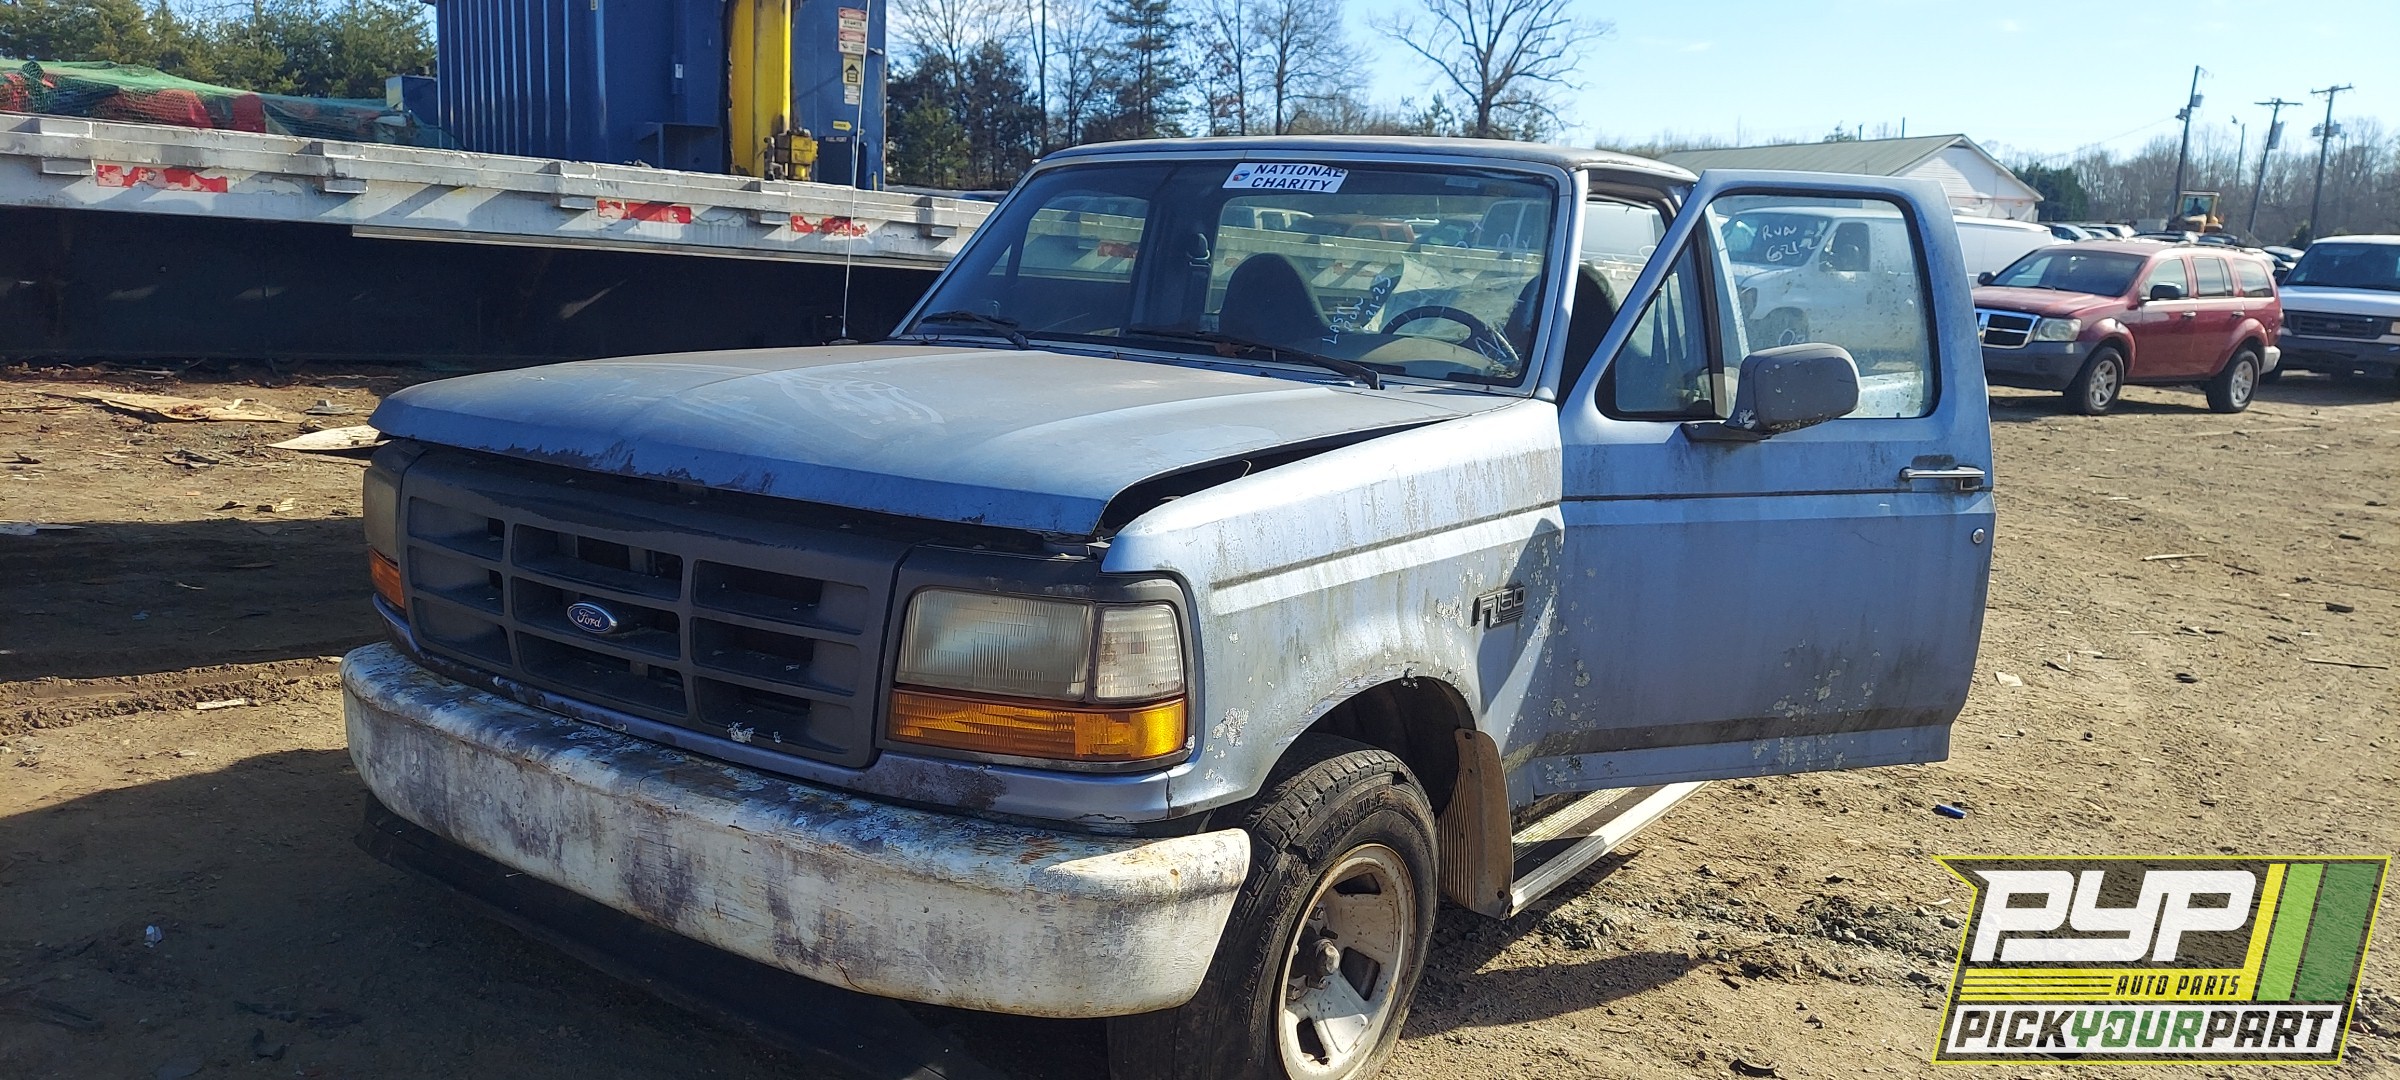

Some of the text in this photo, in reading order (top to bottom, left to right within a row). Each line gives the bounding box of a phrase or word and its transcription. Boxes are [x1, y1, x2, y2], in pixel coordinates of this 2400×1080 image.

[1254, 164, 1344, 178] NATIONAL
[1251, 177, 1333, 191] CHARITY
[577, 608, 602, 627] Ford
